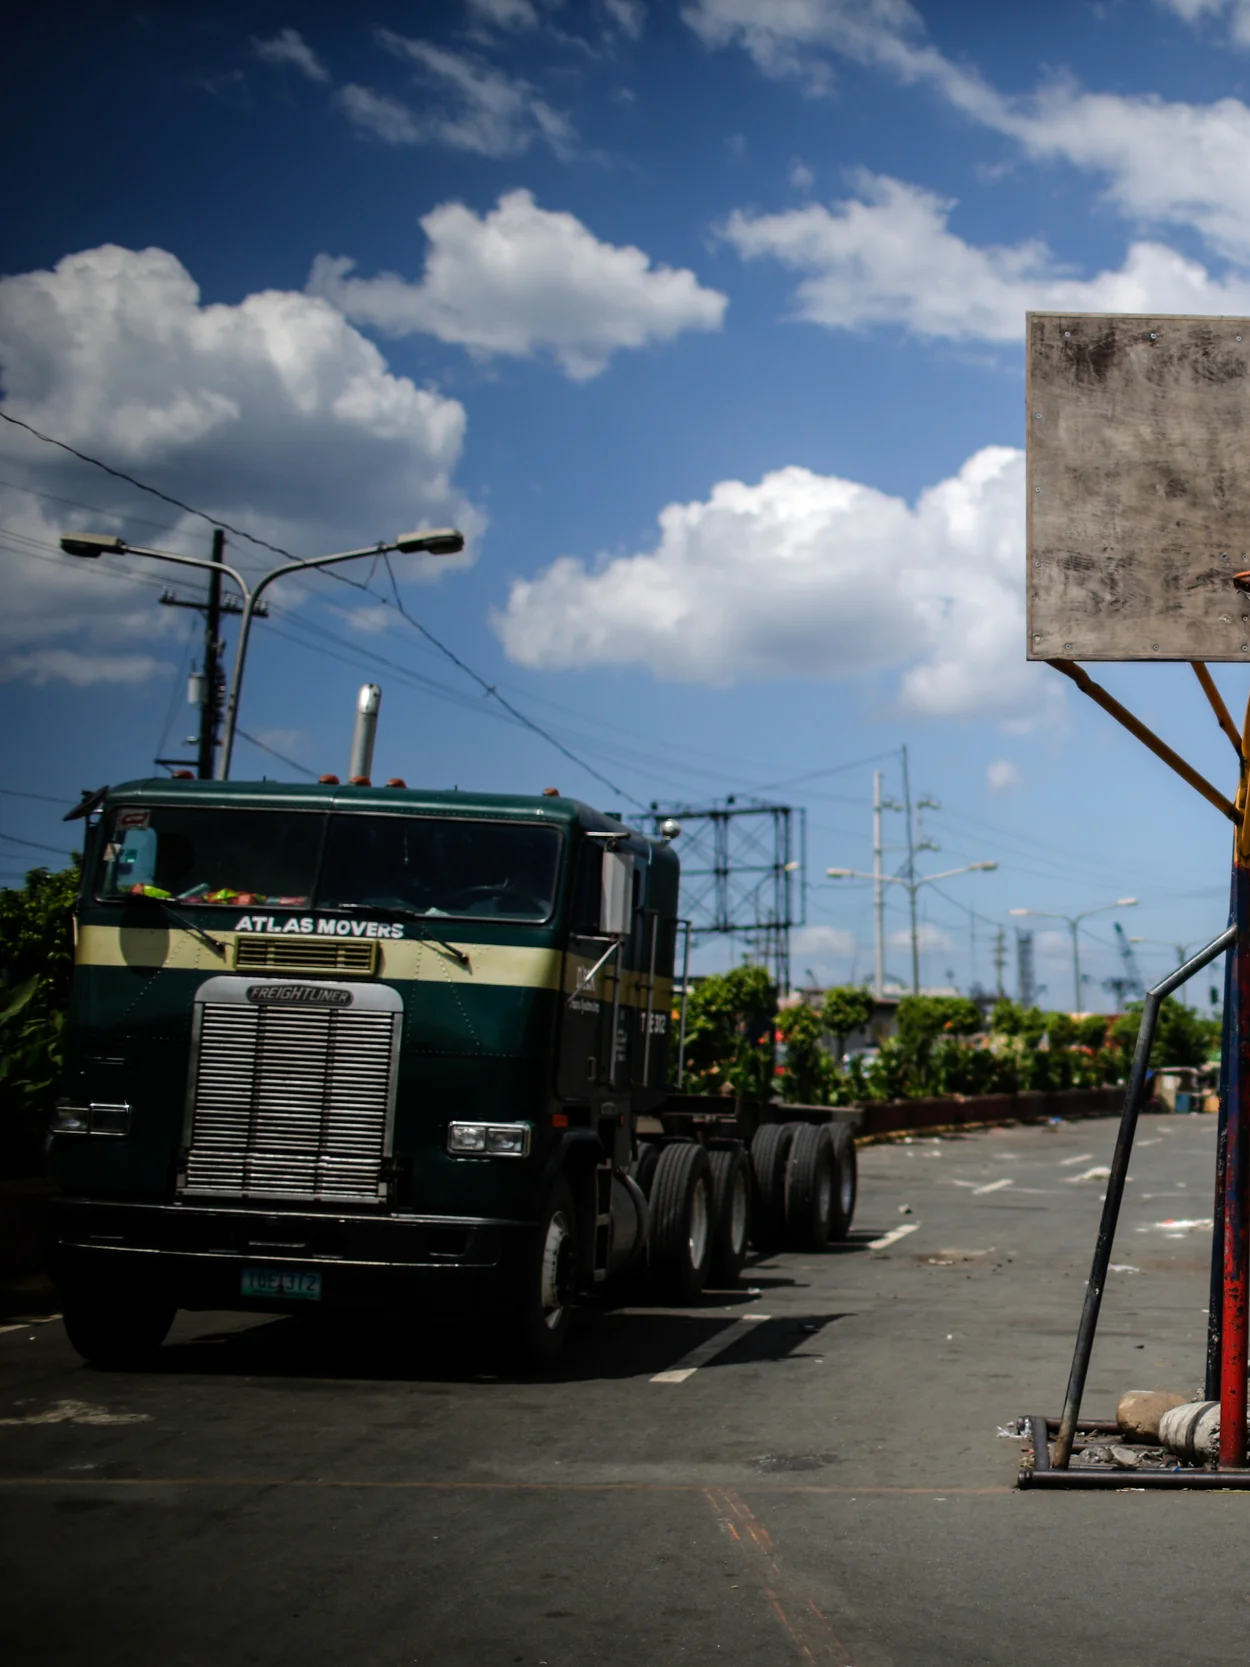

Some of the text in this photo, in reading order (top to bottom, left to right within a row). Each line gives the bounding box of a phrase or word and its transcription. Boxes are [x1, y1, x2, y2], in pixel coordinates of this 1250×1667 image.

[235, 915, 404, 939] ATLAS MOVERS
[251, 986, 349, 1003] FREIGHTLINER
